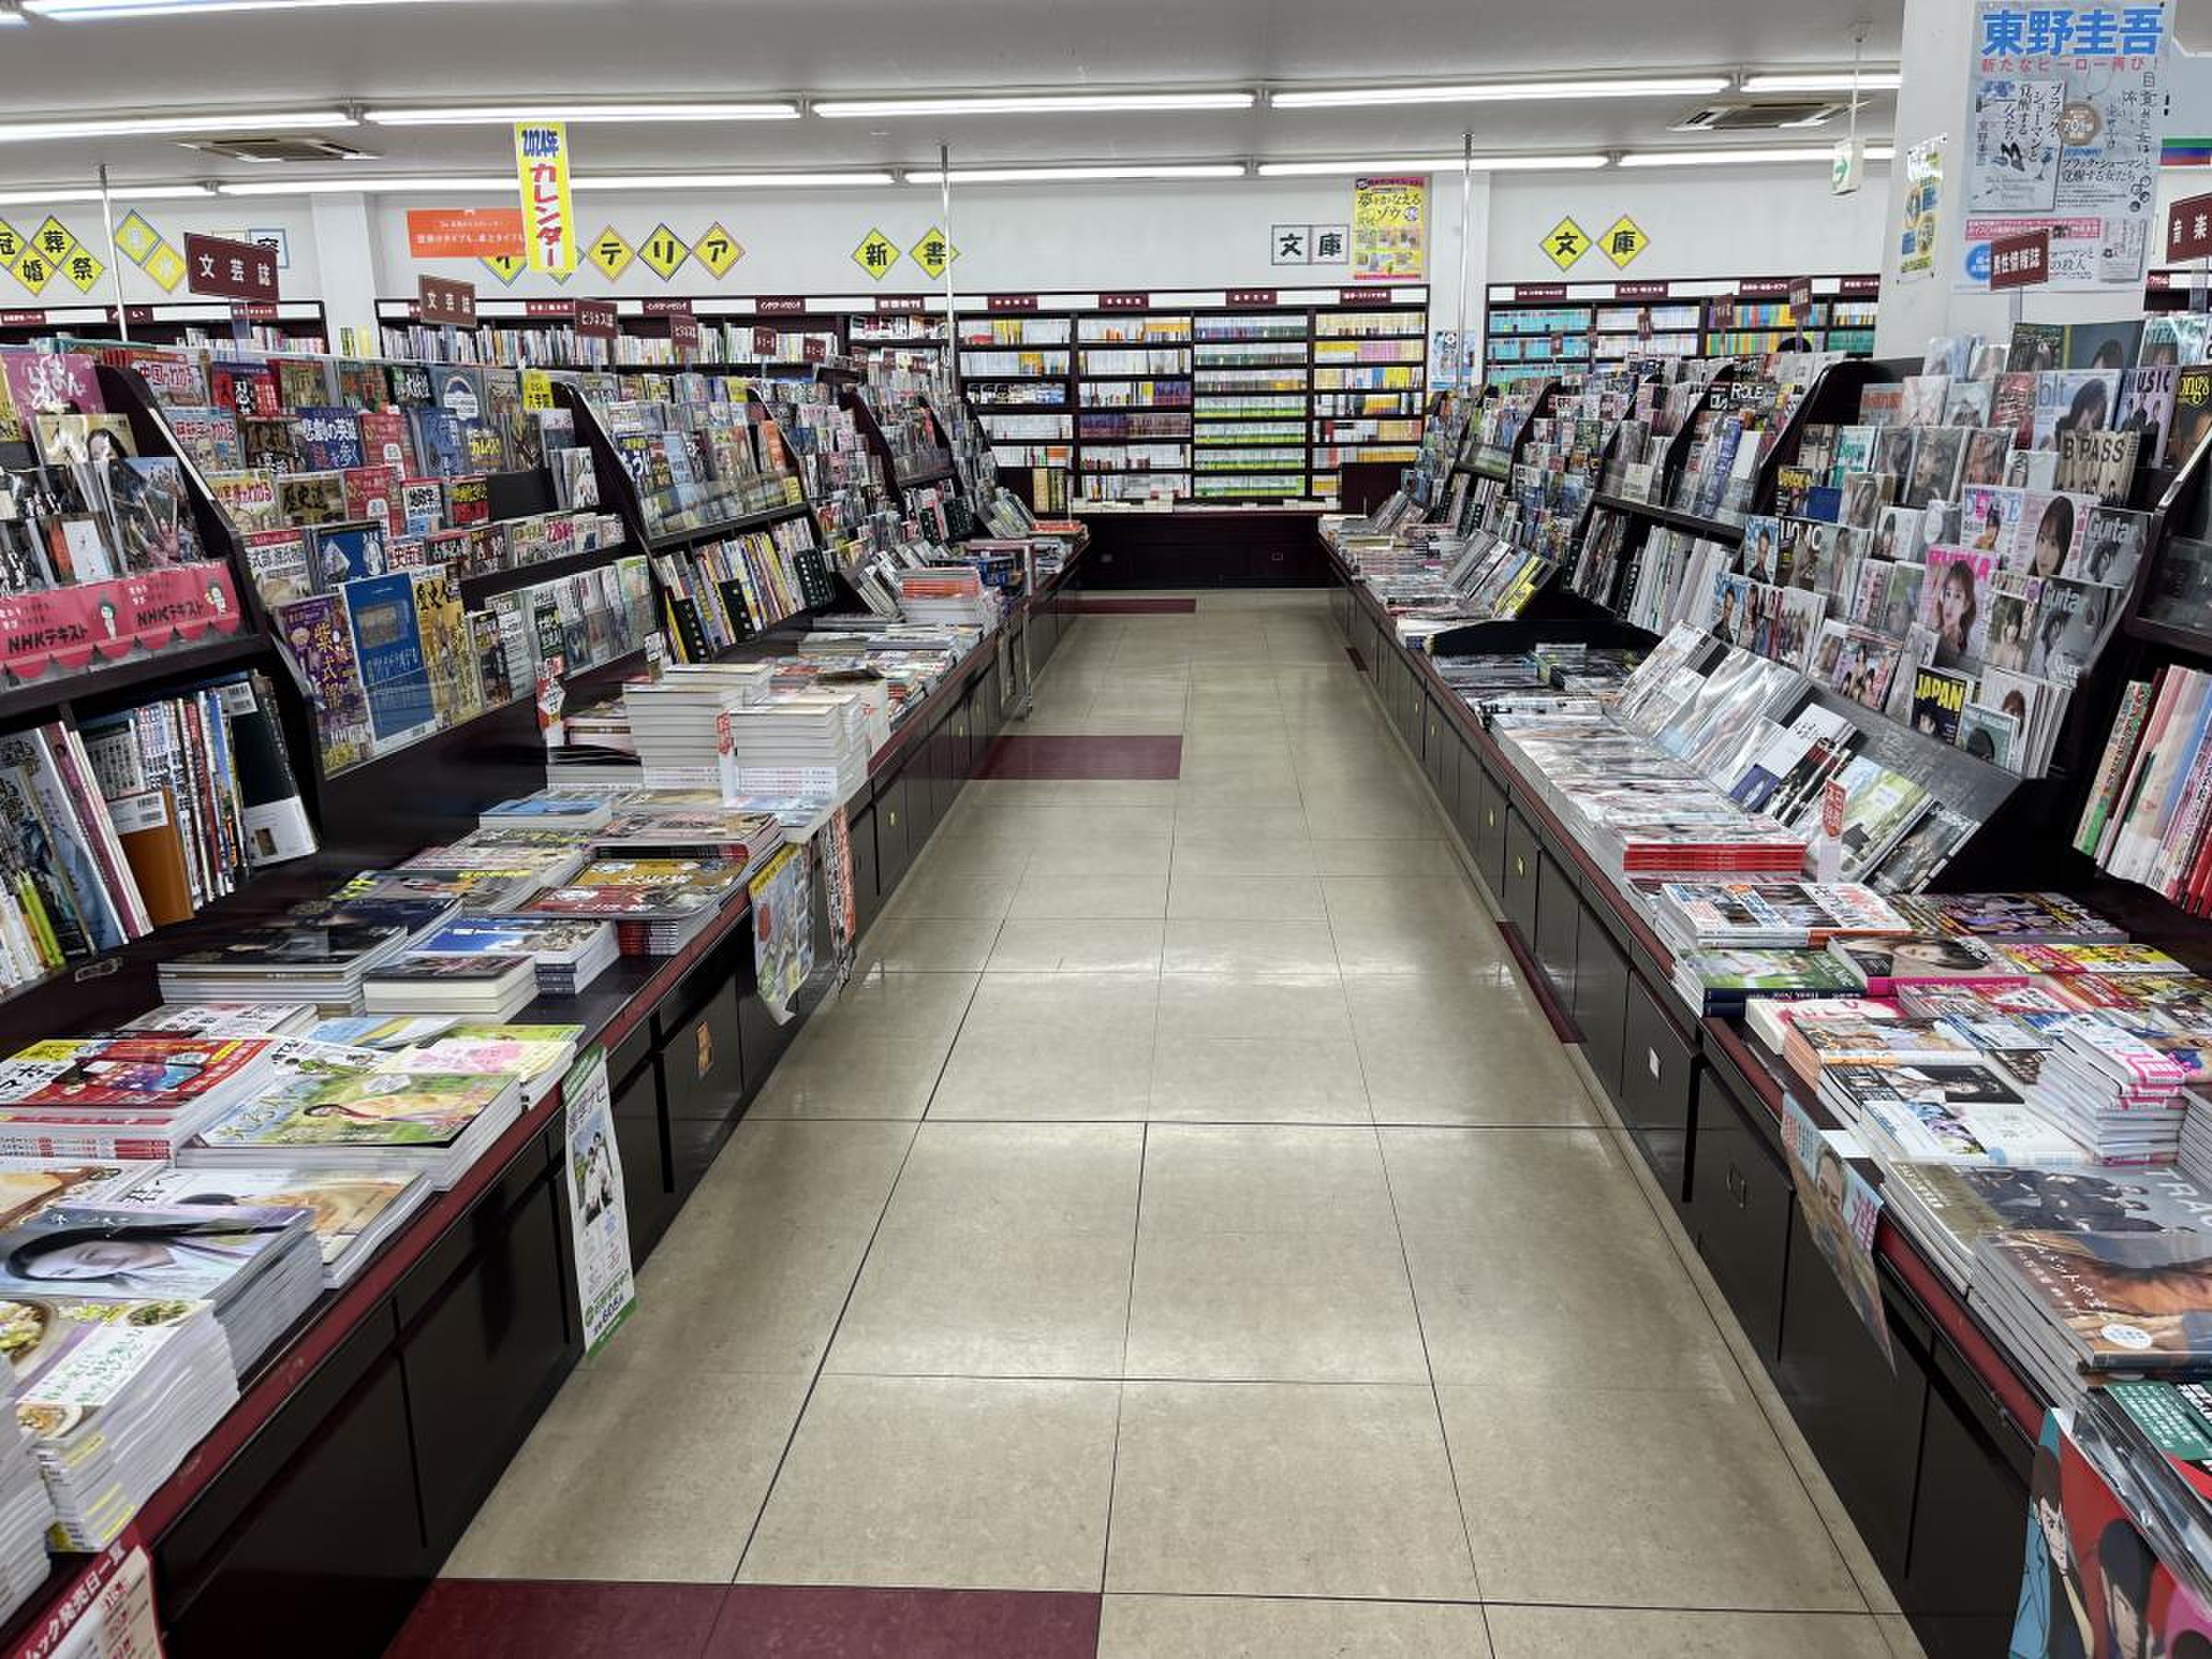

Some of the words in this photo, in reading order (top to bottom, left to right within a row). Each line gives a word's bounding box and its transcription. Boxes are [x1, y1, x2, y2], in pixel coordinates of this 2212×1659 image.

[1982, 9, 2163, 56] 東野圭吾
[522, 129, 559, 158] 2024年
[530, 162, 562, 267] カレンダー
[865, 241, 947, 266] 新書
[1279, 232, 1343, 257] 文庫
[1555, 230, 1636, 255] 文庫
[198, 253, 272, 287] 文芸誌
[137, 602, 206, 627] NHKテキスト
[7, 624, 89, 654] NHKテキスト
[1916, 674, 1964, 712] JAPAN
